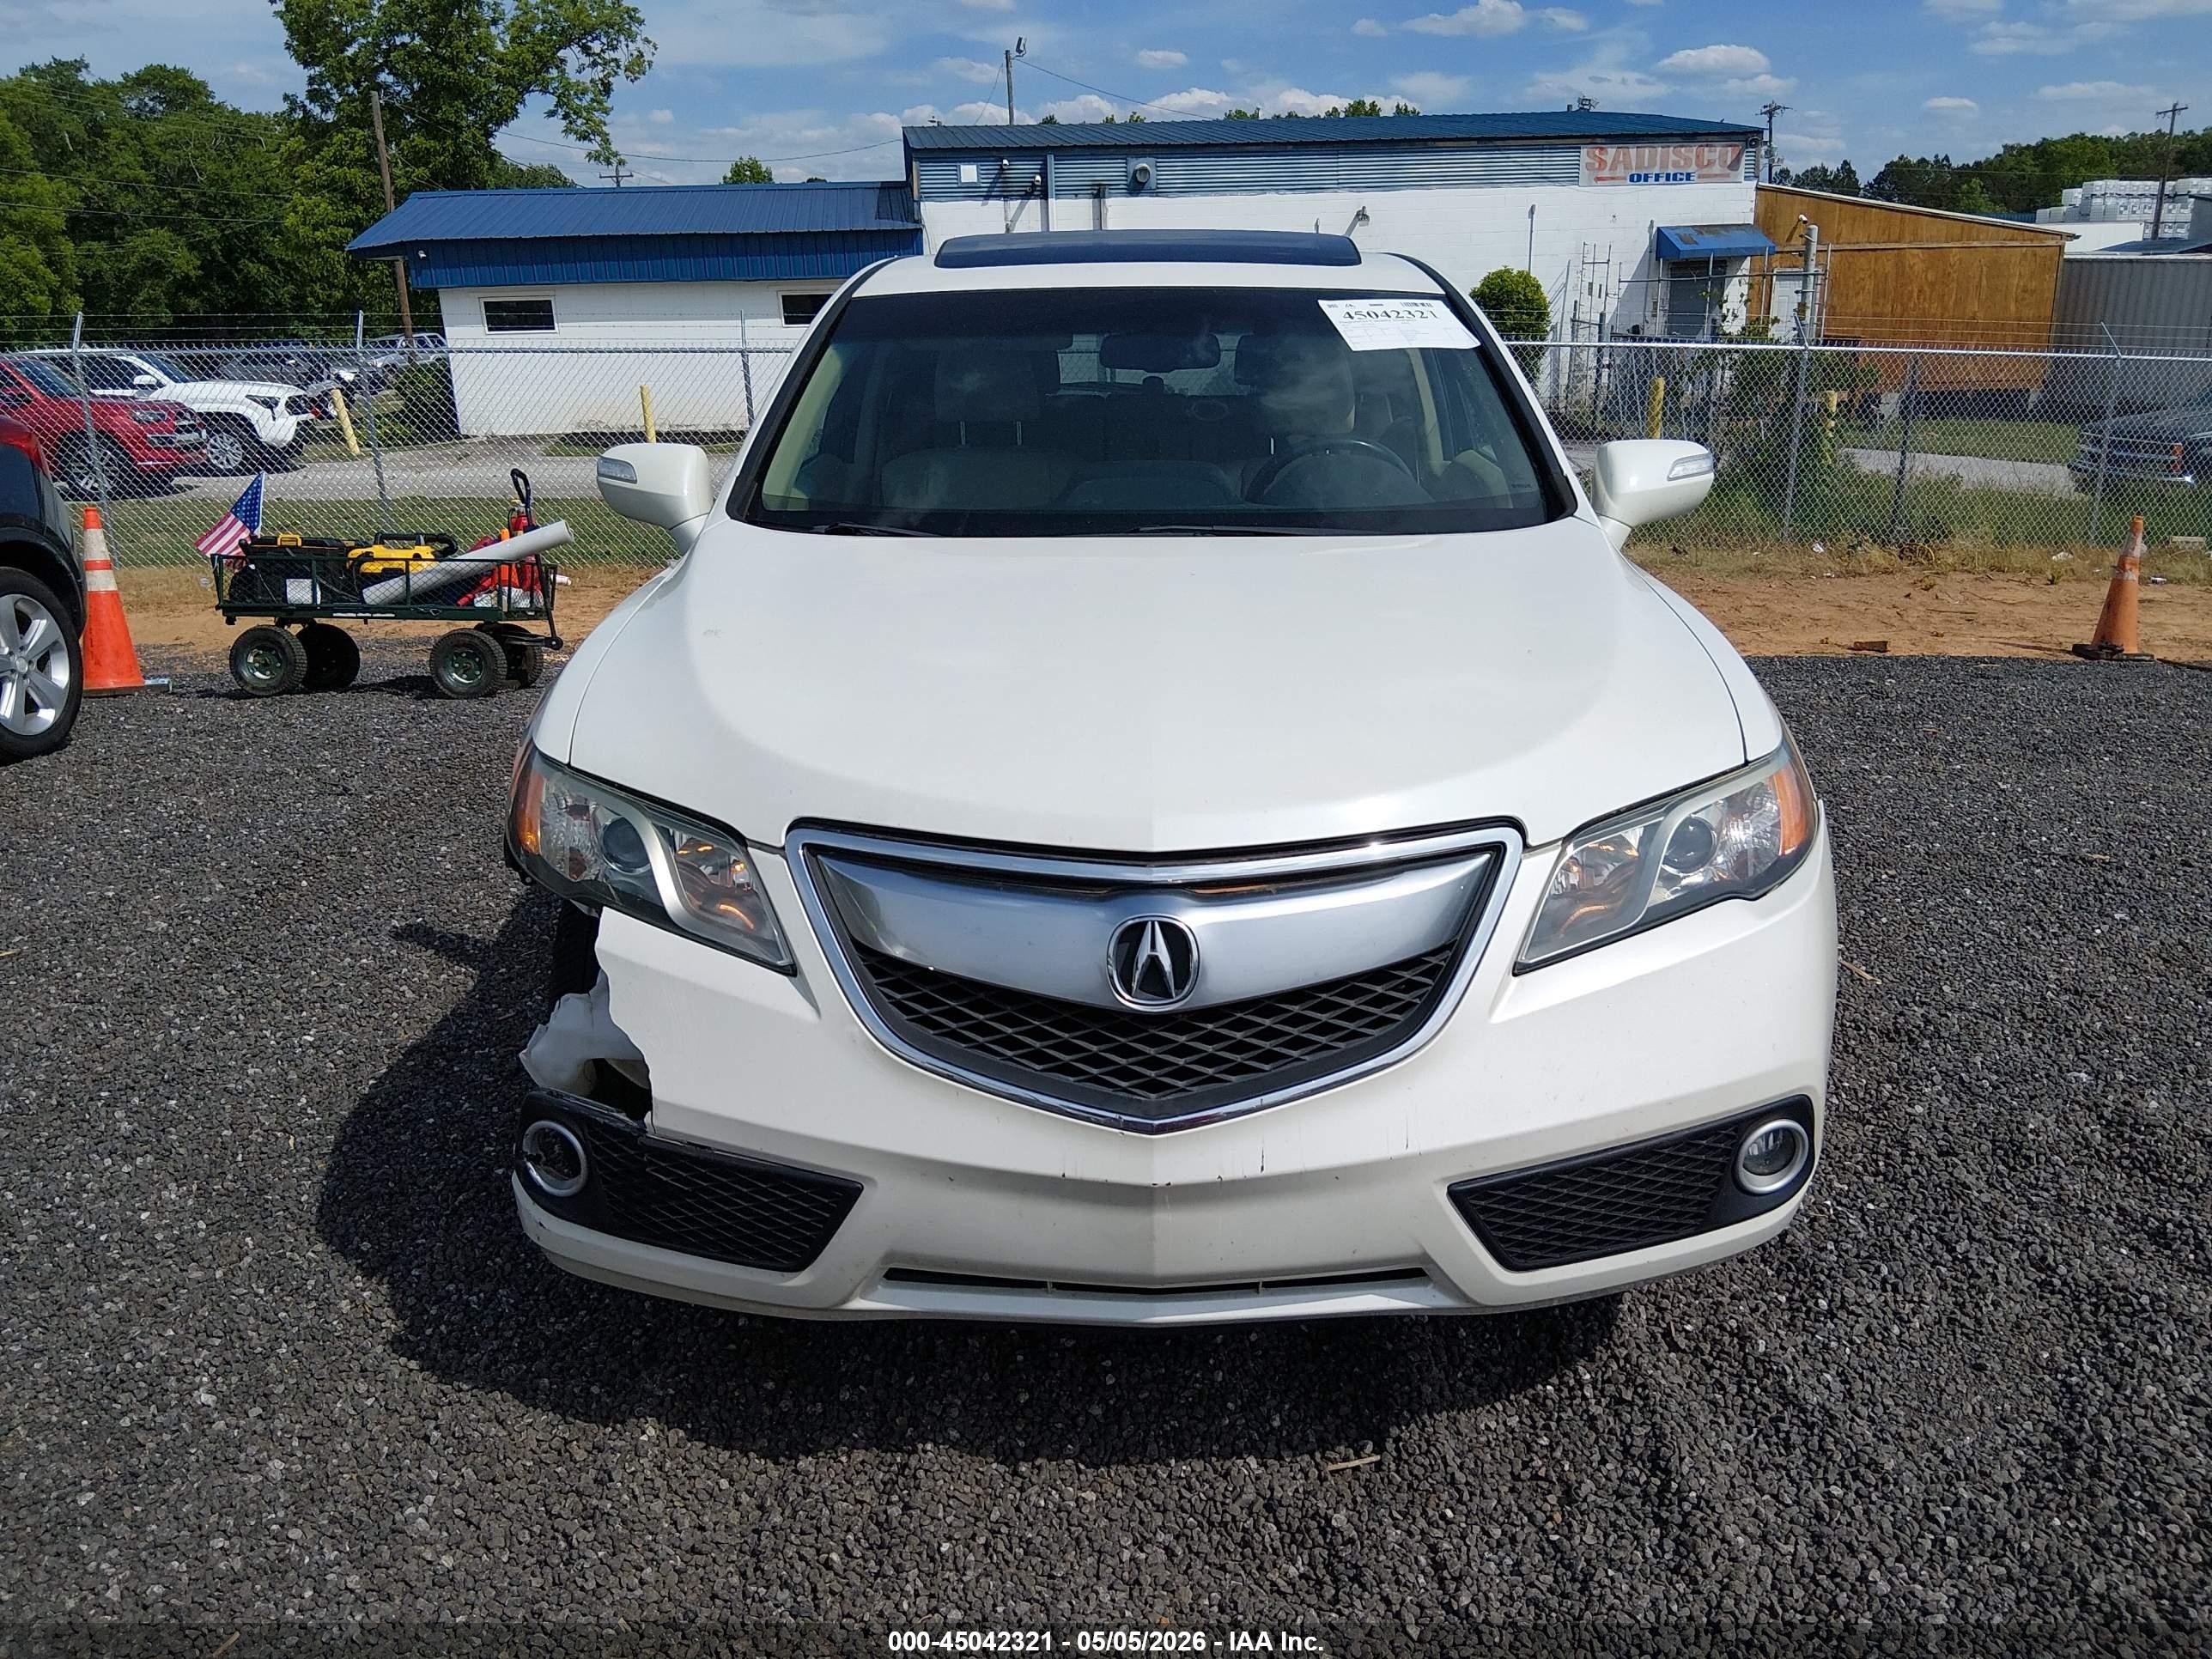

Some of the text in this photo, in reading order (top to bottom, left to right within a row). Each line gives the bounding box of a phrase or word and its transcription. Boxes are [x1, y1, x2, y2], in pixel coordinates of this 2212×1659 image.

[1586, 144, 1744, 171] SADISCO
[1629, 172, 1696, 183] OFFICE
[1343, 310, 1439, 319] 45042321
